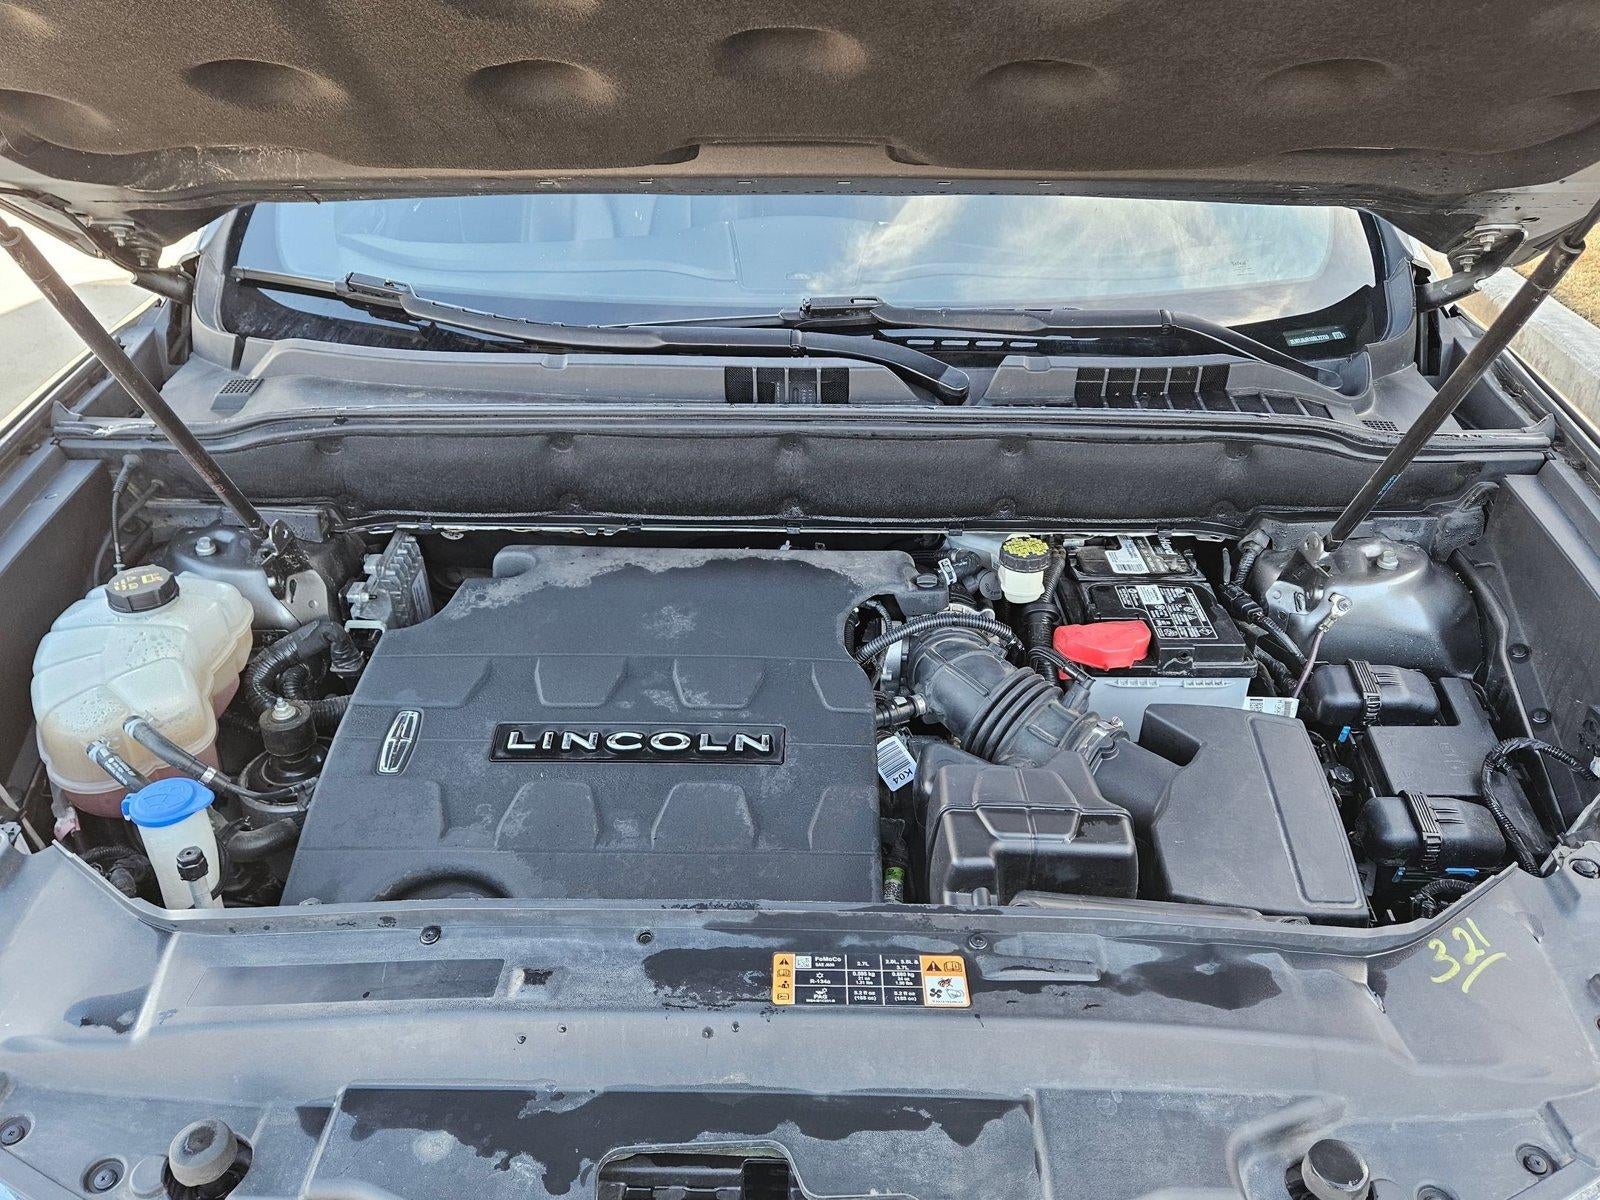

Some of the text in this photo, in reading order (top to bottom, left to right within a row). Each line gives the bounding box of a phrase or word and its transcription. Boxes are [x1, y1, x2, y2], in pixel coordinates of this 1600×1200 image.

[507, 730, 770, 752] LINCOLN
[892, 768, 913, 784] K04
[1427, 917, 1491, 984] 321
